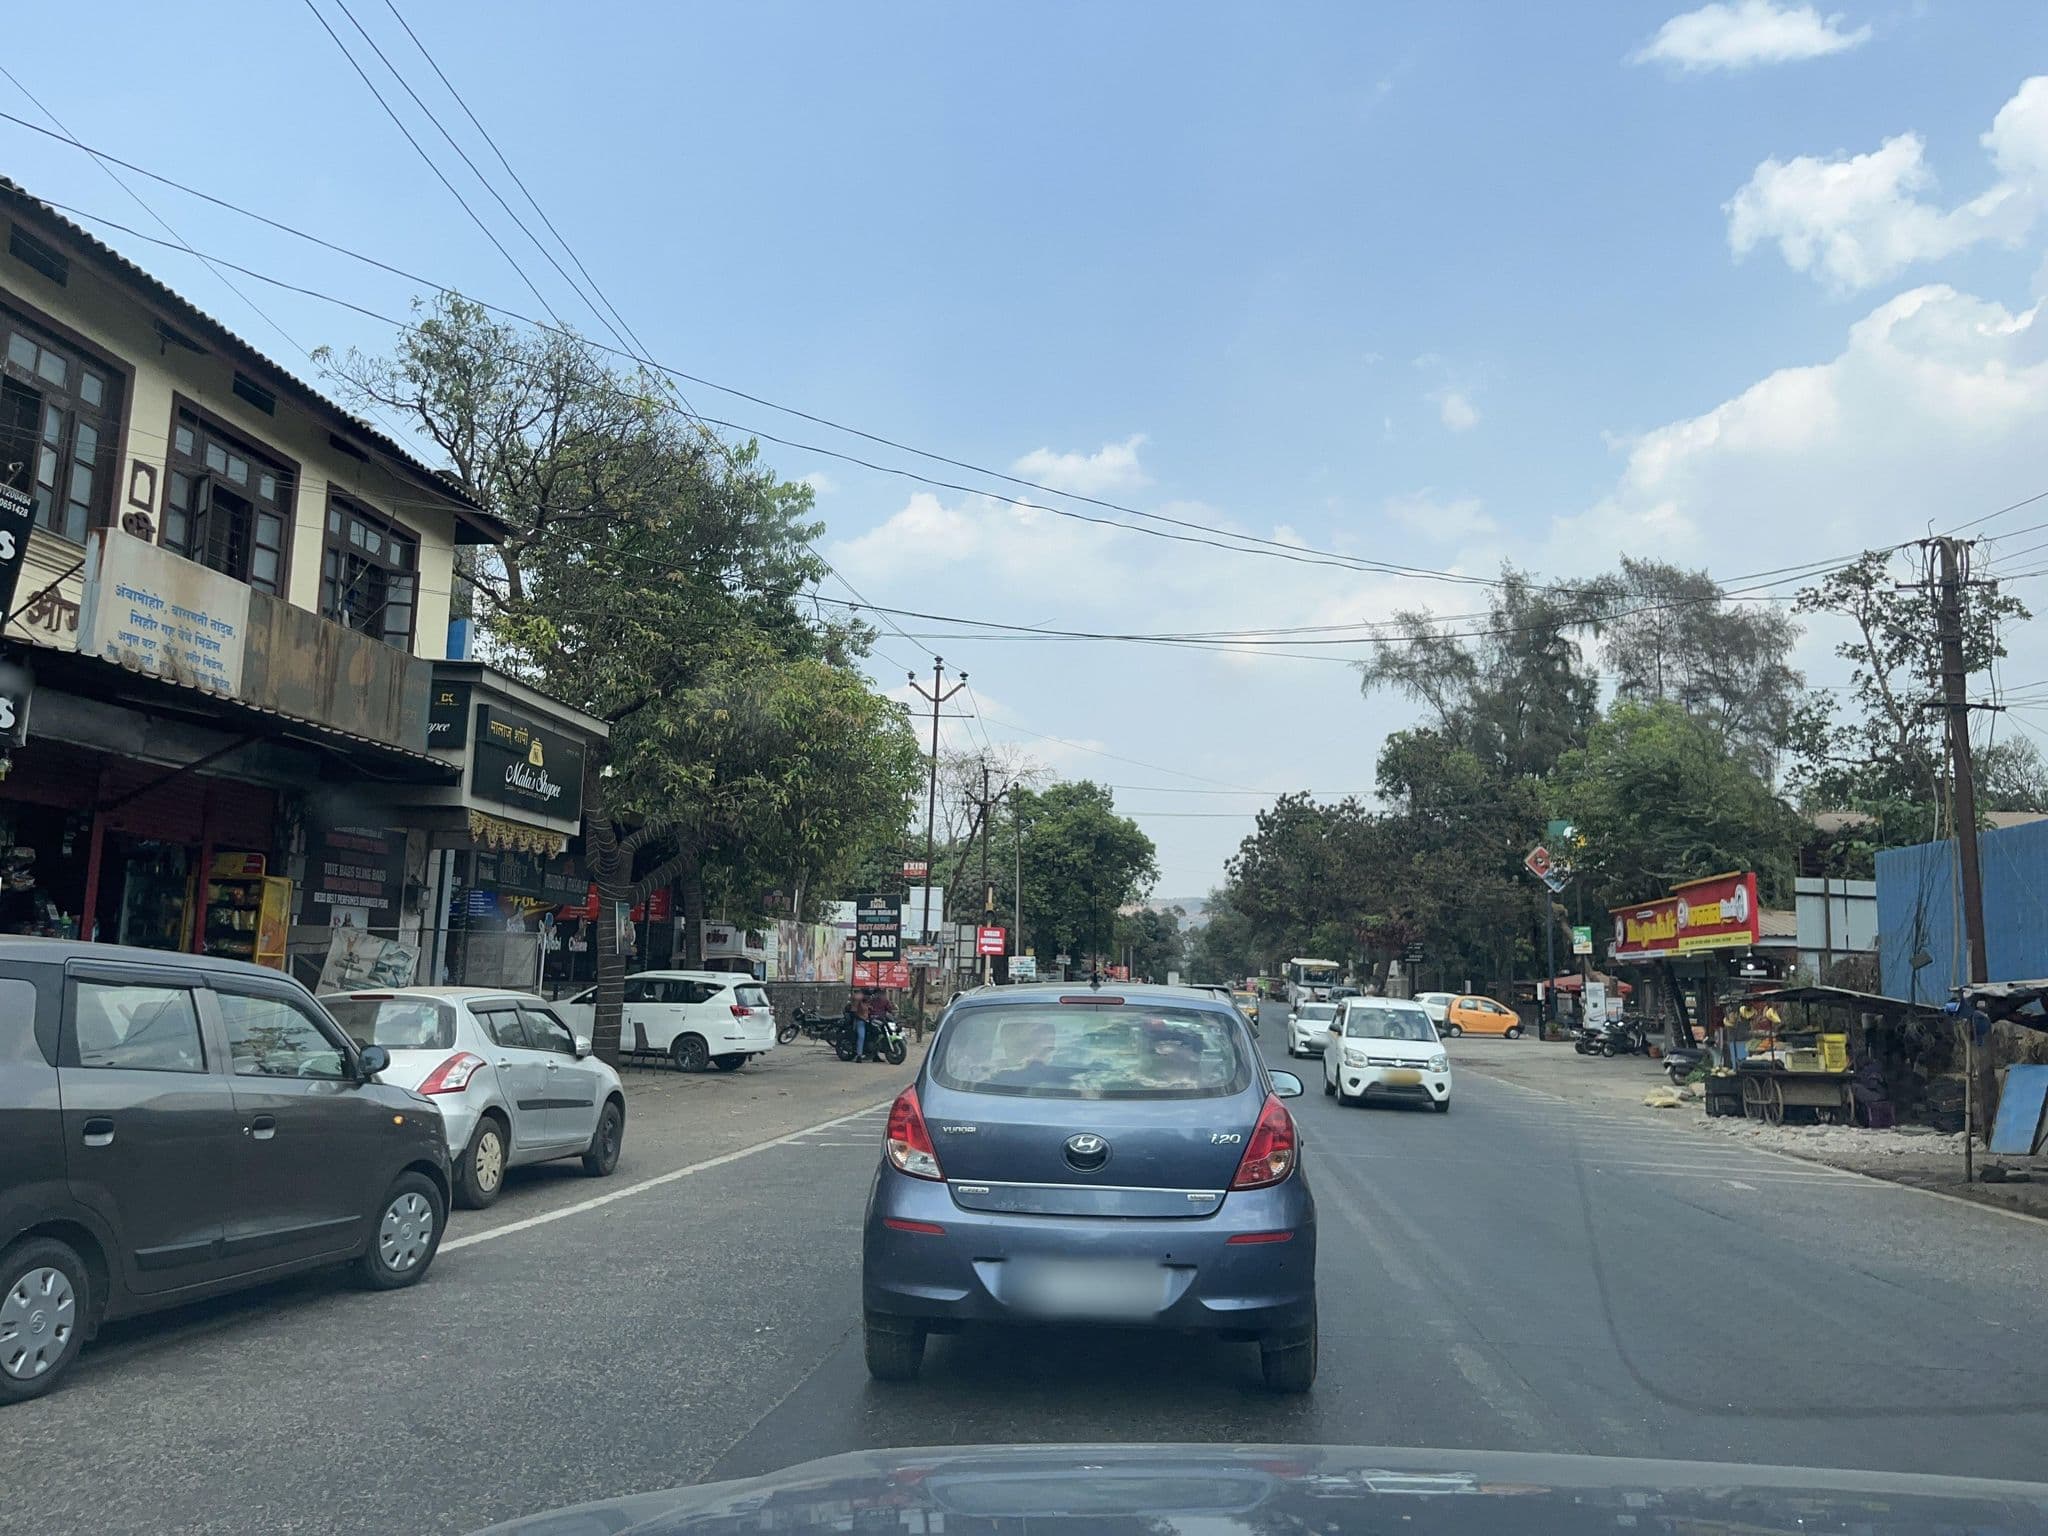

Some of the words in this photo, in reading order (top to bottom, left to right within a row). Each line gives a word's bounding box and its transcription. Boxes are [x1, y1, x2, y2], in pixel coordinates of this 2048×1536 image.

[505, 761, 536, 791] Mala's
[536, 769, 562, 802] Shopee
[860, 934, 869, 948] &
[871, 934, 897, 948] BAR
